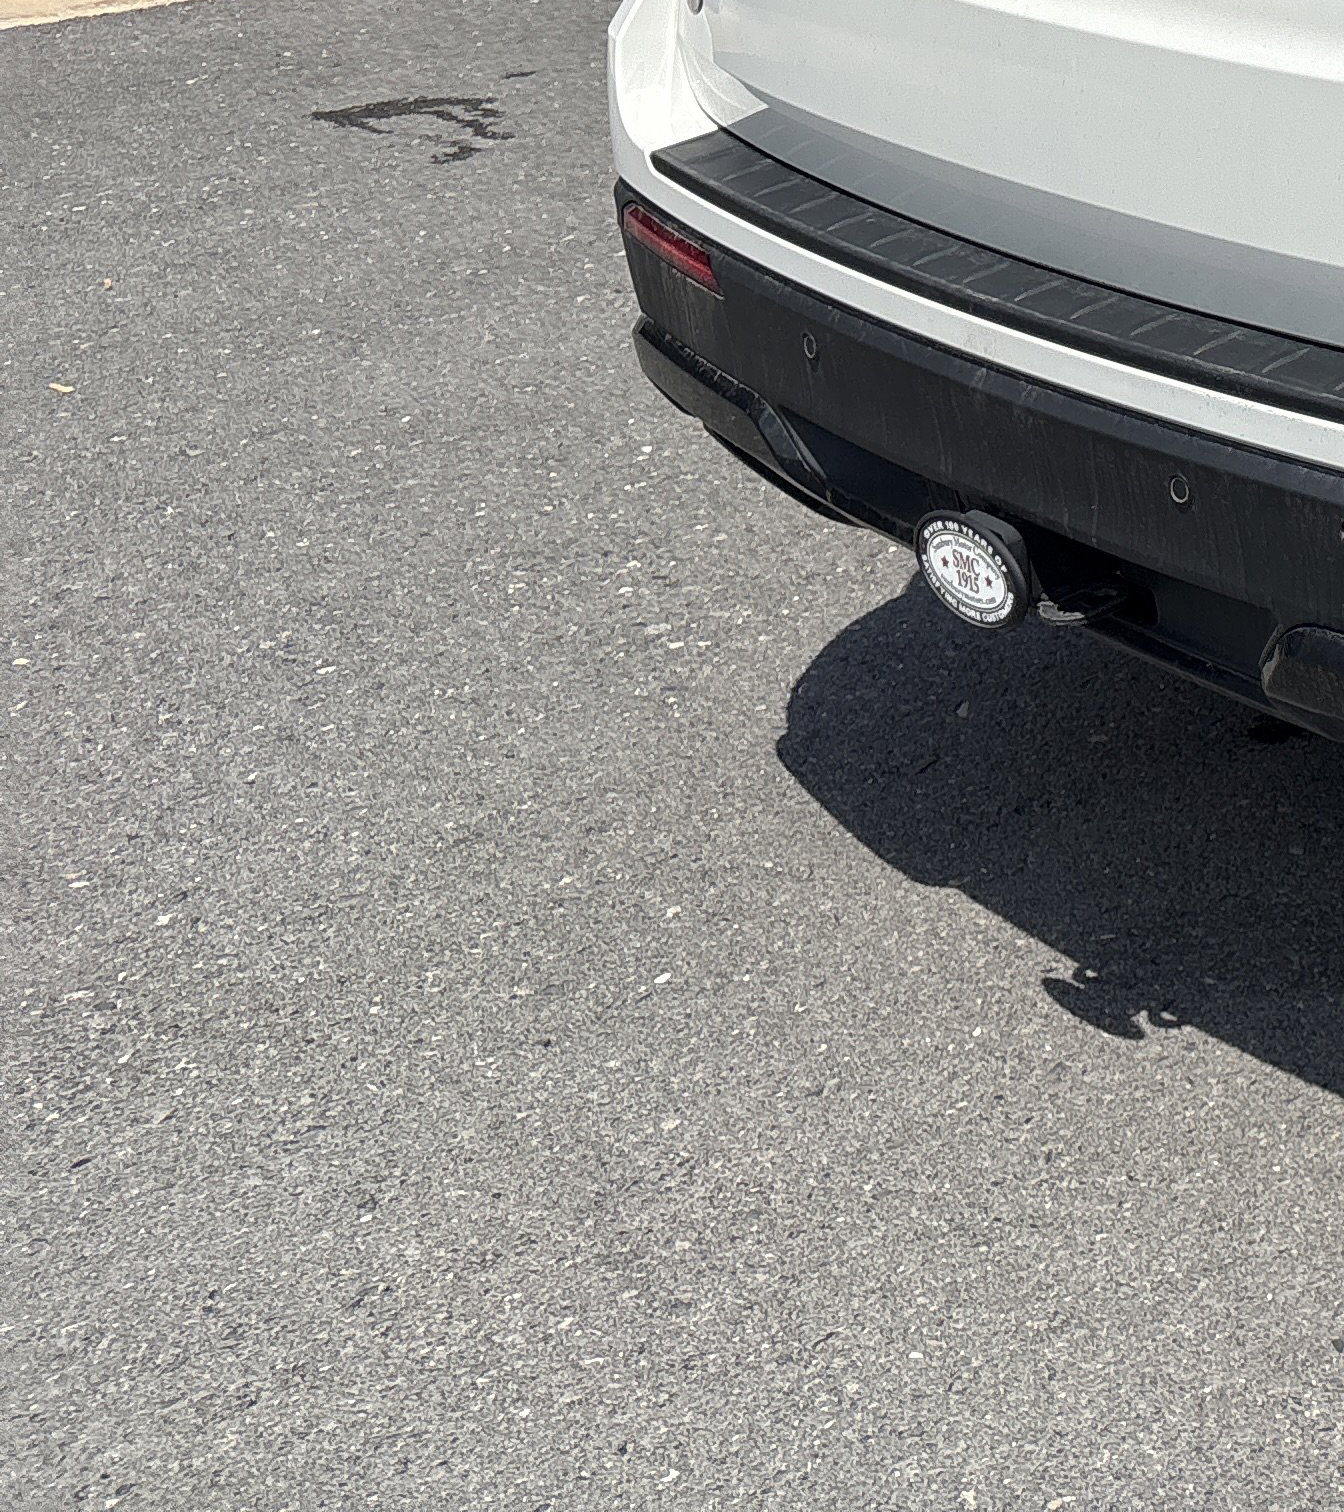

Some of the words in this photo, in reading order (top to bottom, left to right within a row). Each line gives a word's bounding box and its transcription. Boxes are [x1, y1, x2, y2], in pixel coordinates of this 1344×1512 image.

[923, 520, 945, 540] OVER
[961, 524, 993, 555] YEARS
[952, 549, 980, 577] SMC
[956, 569, 979, 594] 1915
